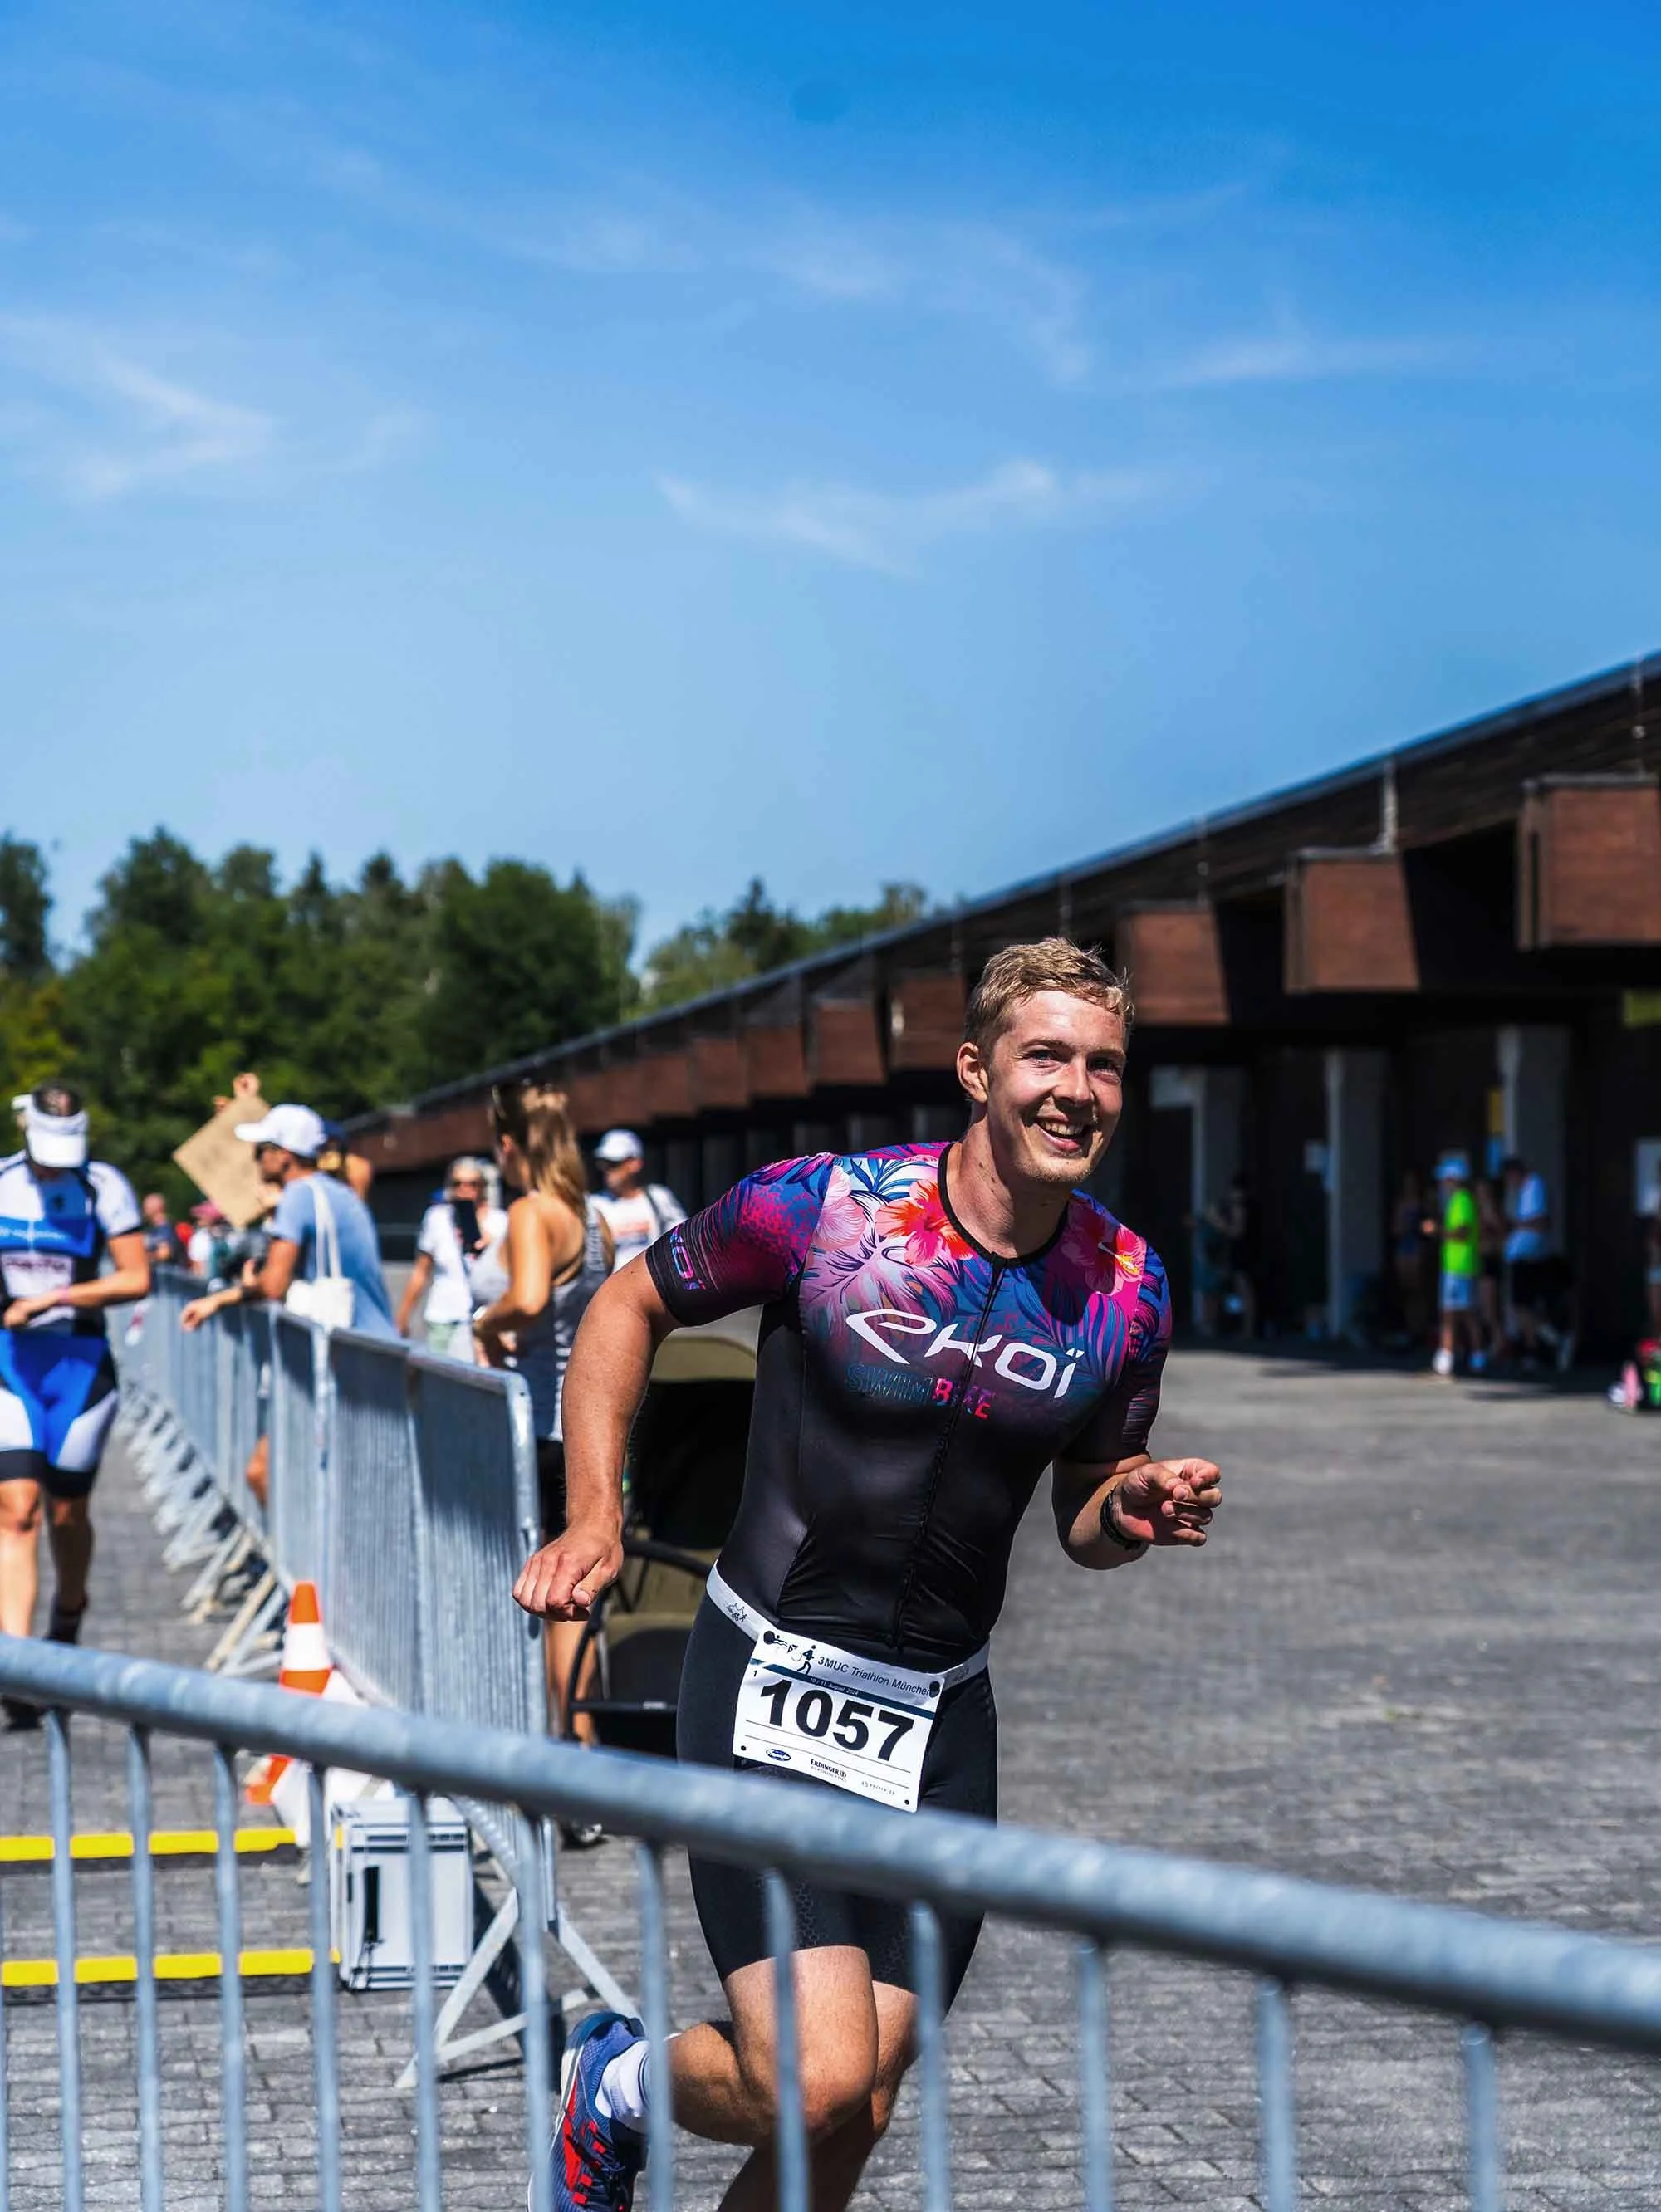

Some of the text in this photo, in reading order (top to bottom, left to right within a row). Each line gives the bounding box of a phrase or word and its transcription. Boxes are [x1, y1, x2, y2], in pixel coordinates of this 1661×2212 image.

[817, 1656, 849, 1672] 3MUC
[850, 1666, 889, 1686] Triathlon
[760, 1679, 915, 1762] 1057
[811, 1759, 840, 1776] ERDINGER
